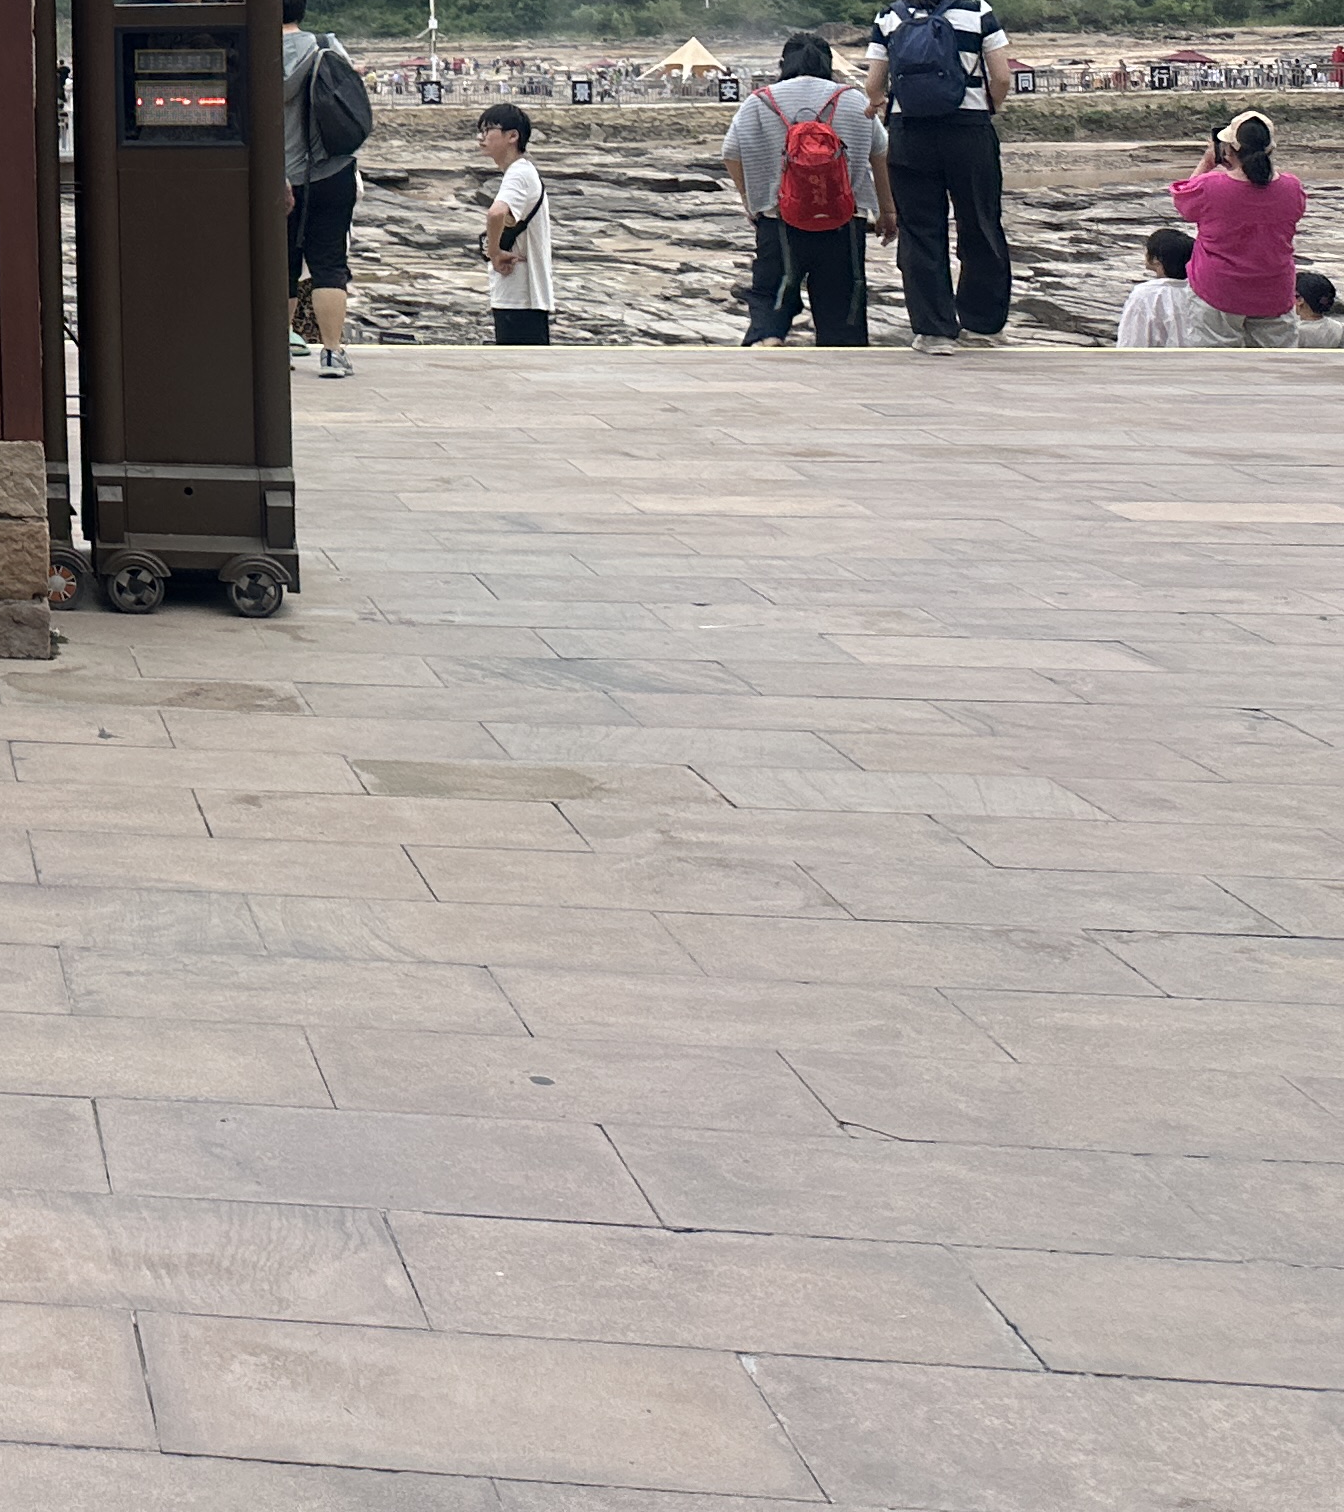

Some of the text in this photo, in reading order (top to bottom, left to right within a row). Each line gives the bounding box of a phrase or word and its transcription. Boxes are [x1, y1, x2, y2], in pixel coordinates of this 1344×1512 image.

[1018, 72, 1034, 92] 同
[1152, 69, 1170, 88] 行
[423, 83, 440, 102] 美
[720, 81, 738, 100] 安
